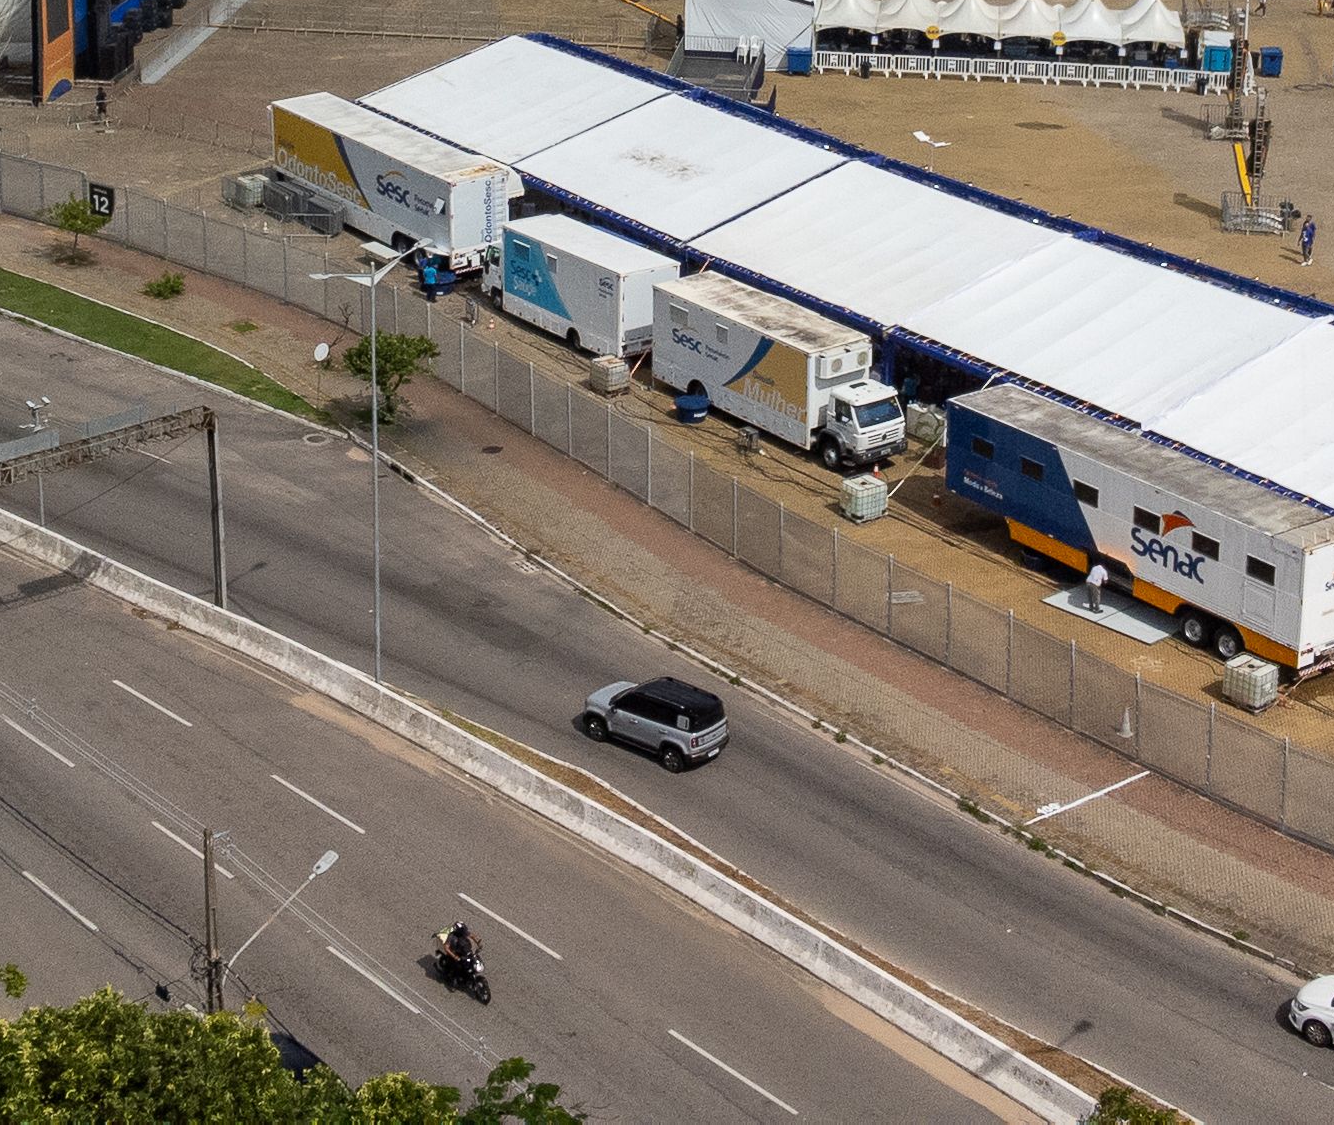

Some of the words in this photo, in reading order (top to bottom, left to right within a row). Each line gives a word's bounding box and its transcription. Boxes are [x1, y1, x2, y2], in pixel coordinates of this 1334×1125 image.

[93, 194, 110, 214] 12
[376, 174, 410, 208] Sesc
[484, 179, 493, 243] OdontoSesc
[672, 328, 702, 355] Sesc
[1130, 527, 1205, 584] Senac
